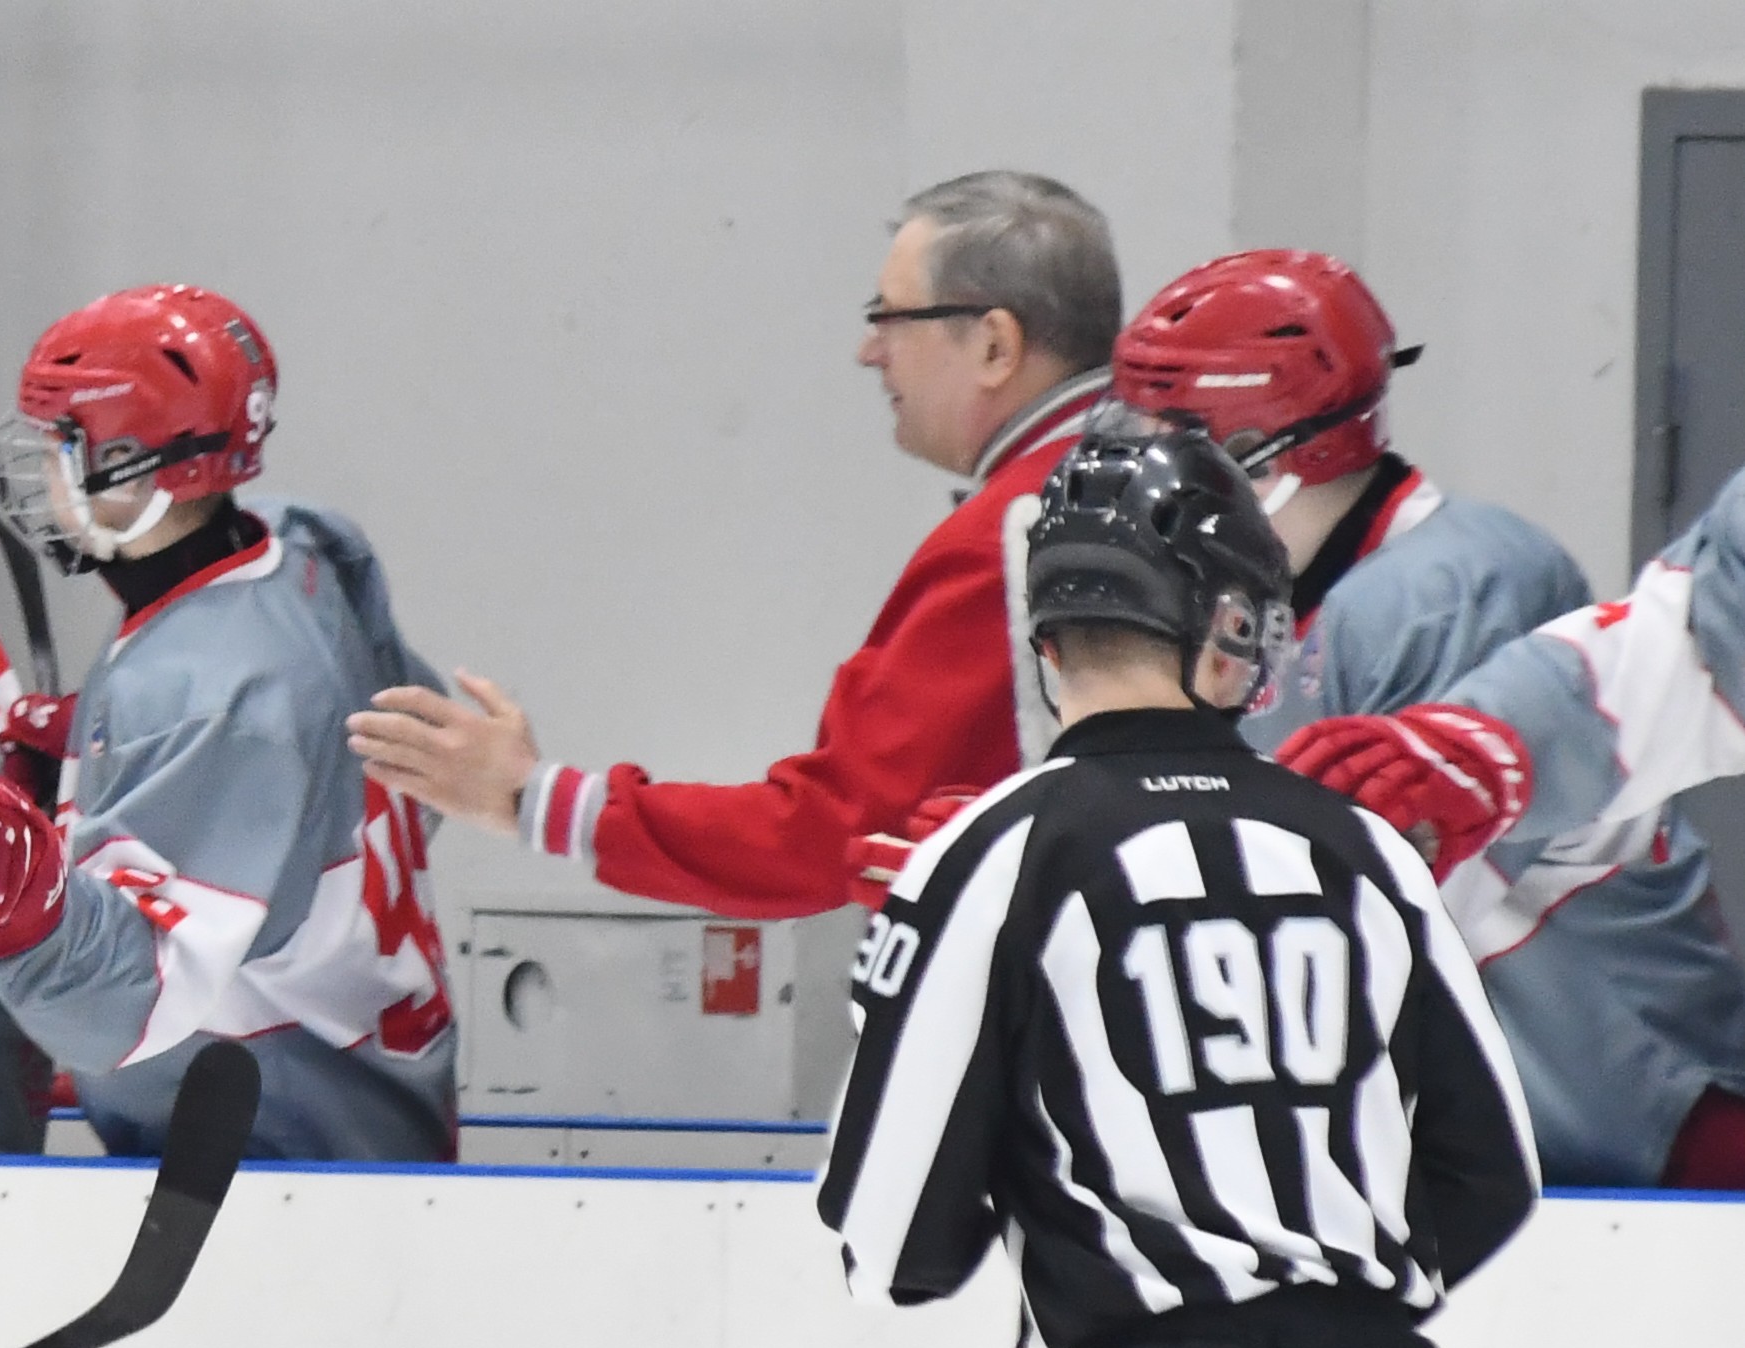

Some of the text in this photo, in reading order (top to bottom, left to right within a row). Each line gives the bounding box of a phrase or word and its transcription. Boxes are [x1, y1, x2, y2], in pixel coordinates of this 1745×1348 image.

[1141, 775, 1231, 792] LUTCH
[850, 912, 921, 998] 90
[1121, 916, 1350, 1095] 190
